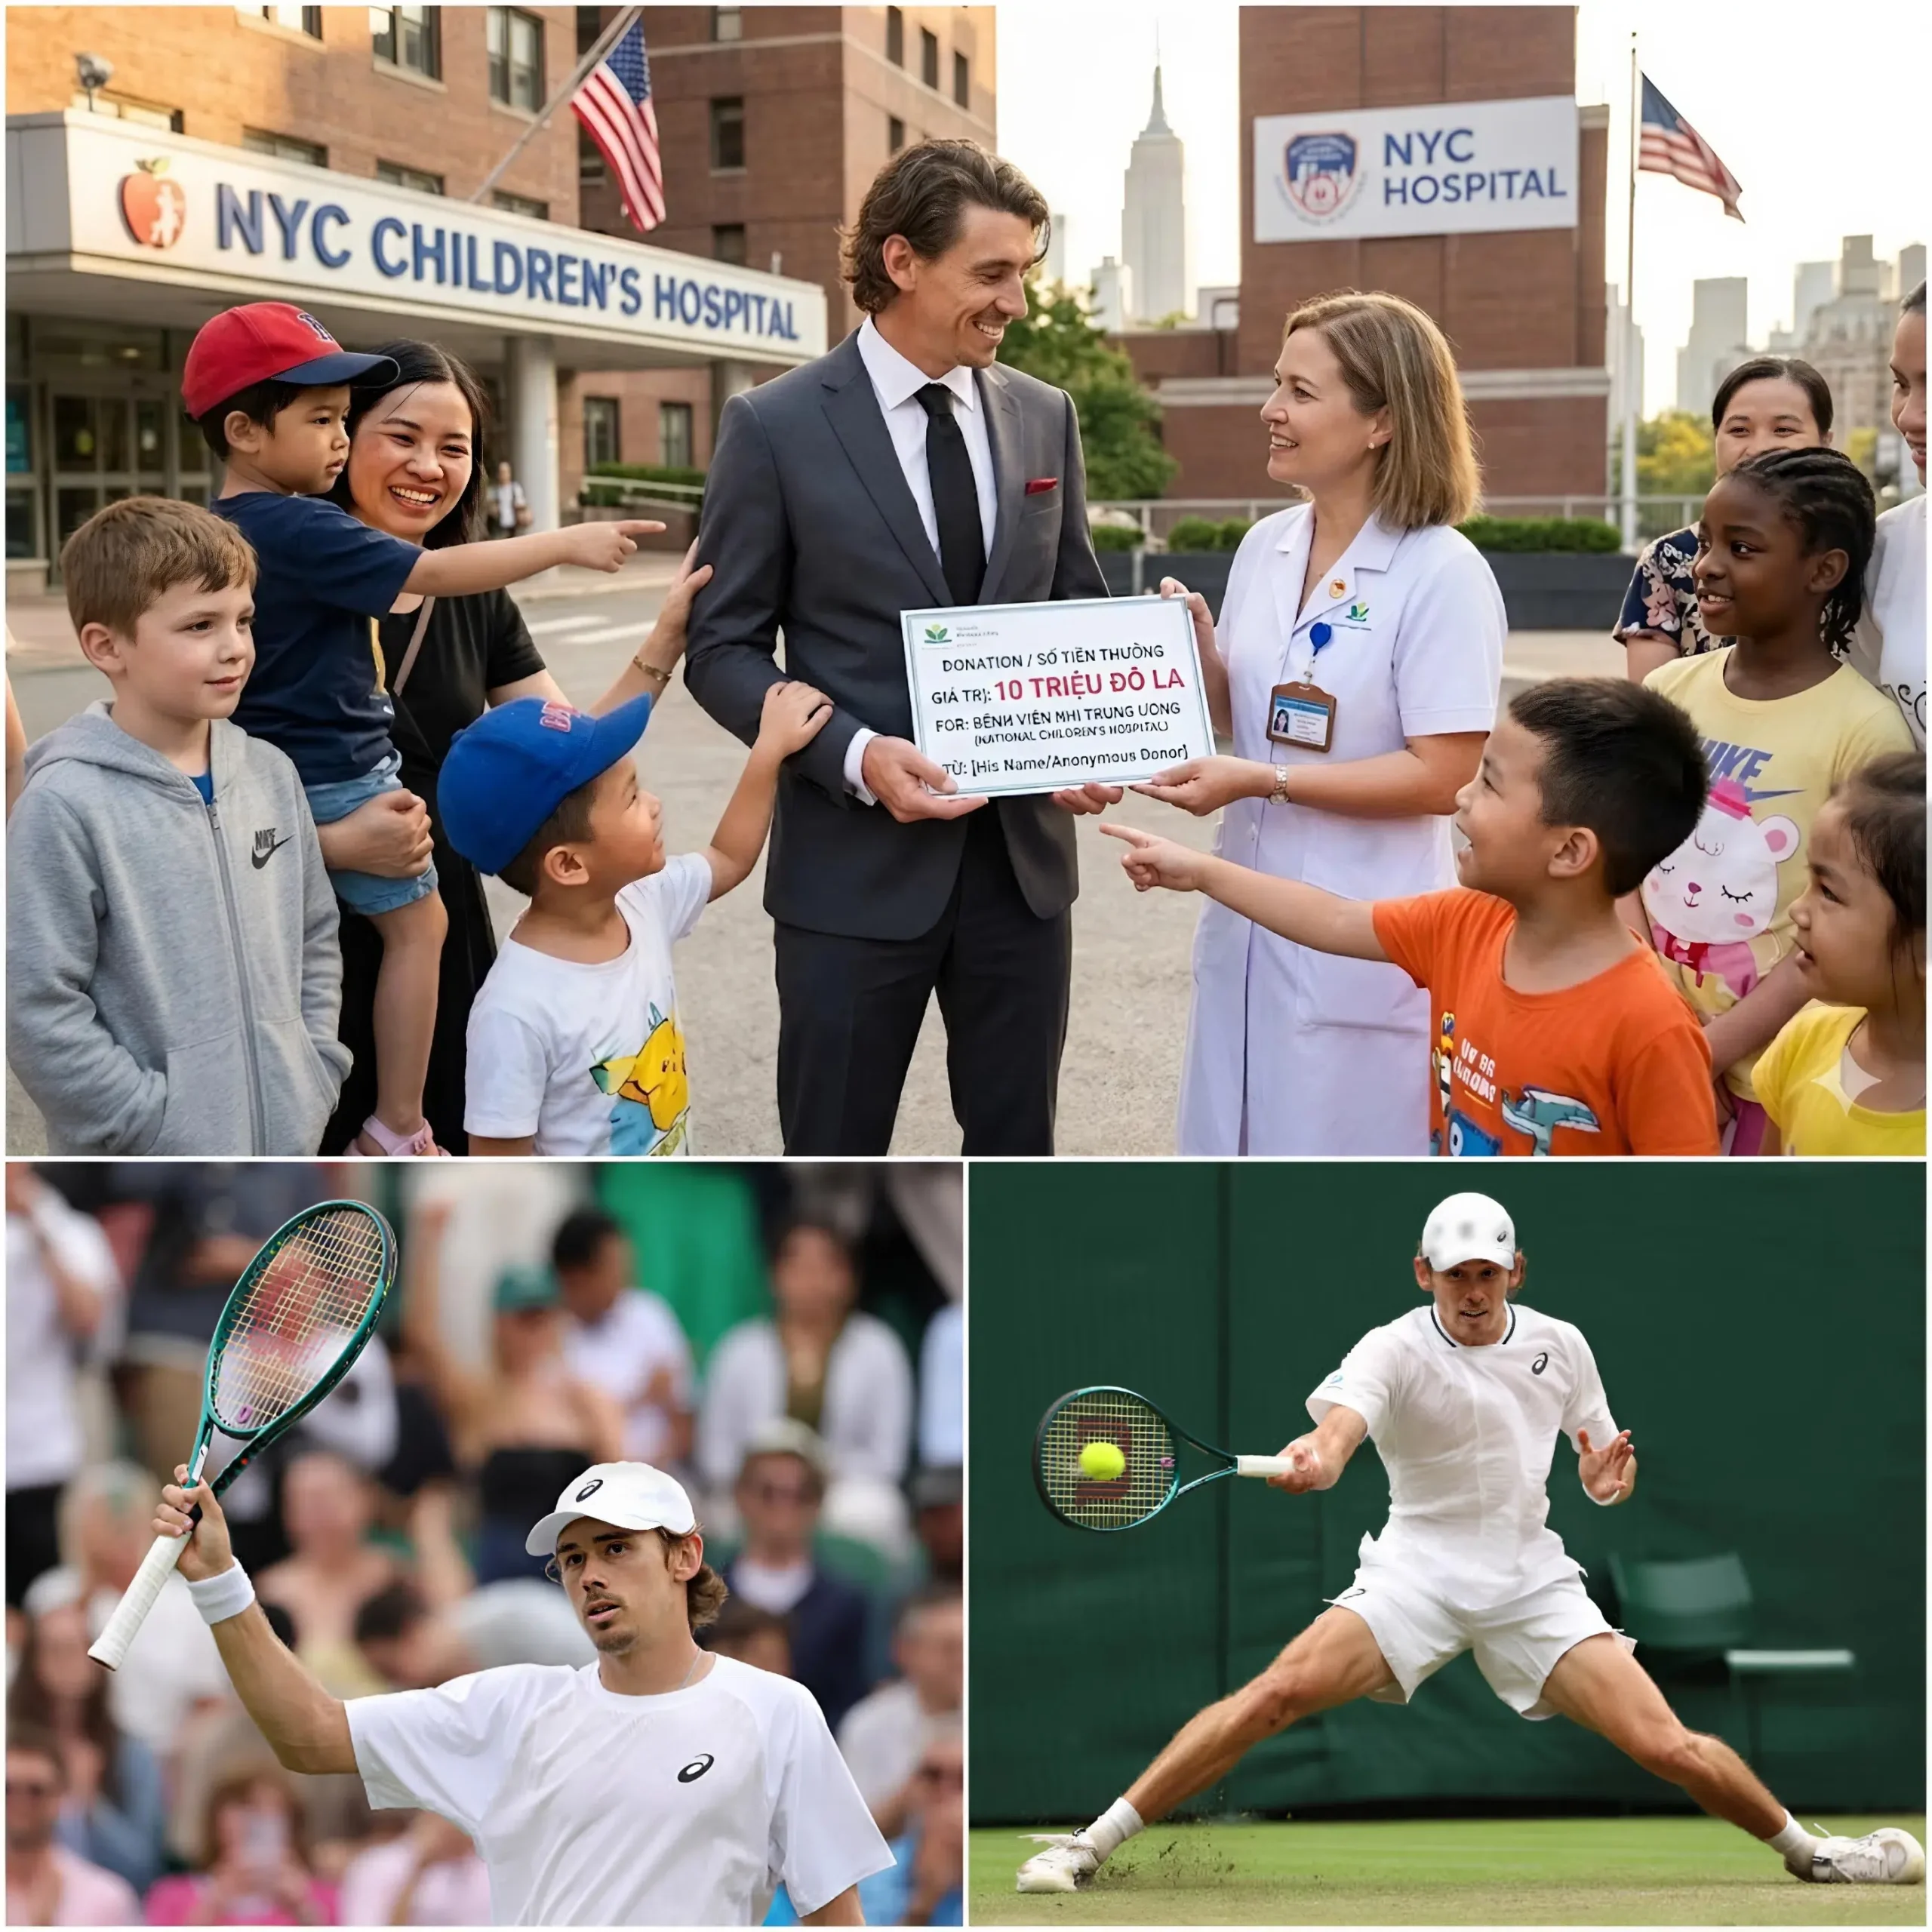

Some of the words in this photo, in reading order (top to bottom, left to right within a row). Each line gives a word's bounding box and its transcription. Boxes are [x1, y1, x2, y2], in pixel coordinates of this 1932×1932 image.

[1384, 128, 1475, 167] NYC
[1383, 168, 1567, 206] HOSPITAL
[217, 183, 352, 269] NYC
[371, 217, 643, 316] CHILDREN'S
[654, 273, 800, 341] HOSPITAL
[942, 654, 1023, 672] DONATION
[994, 679, 1023, 701] 10
[1152, 668, 1186, 690] LA
[935, 718, 970, 733] FOR:
[1083, 705, 1134, 721] TRUNG
